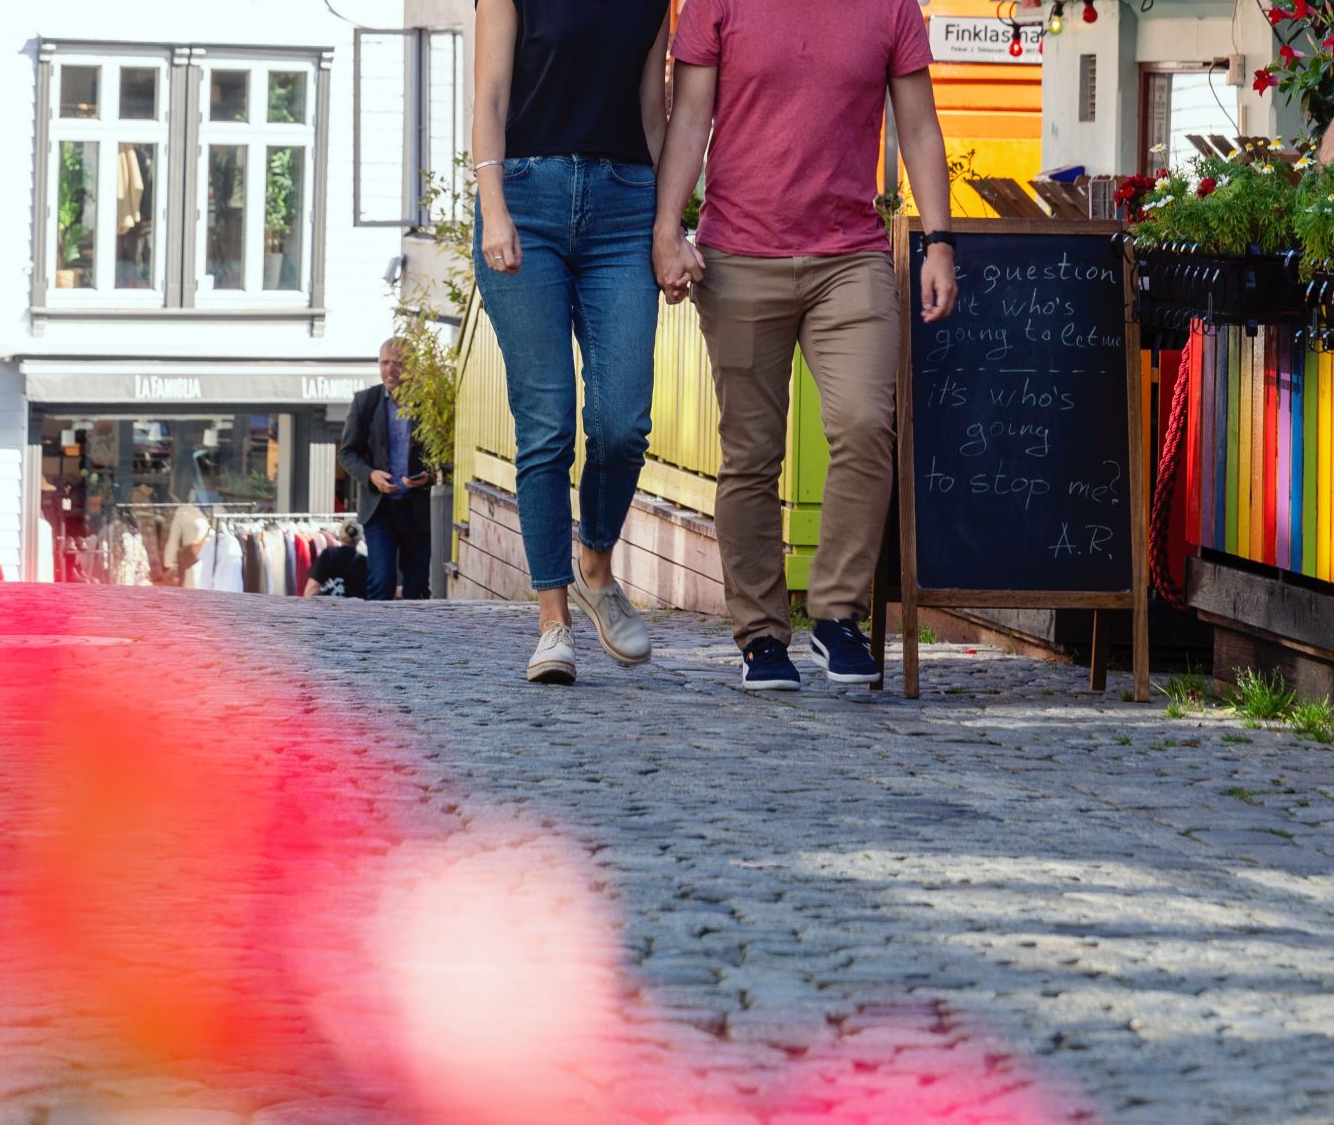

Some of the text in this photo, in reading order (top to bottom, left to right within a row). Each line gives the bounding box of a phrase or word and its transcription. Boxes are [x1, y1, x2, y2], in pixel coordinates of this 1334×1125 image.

[983, 252, 1117, 294] question
[1003, 287, 1075, 317] who's
[927, 328, 1013, 363] going
[1025, 318, 1051, 342] to
[927, 374, 1075, 410] it's who's
[959, 417, 1051, 458] going
[923, 455, 1121, 511] to stop me?
